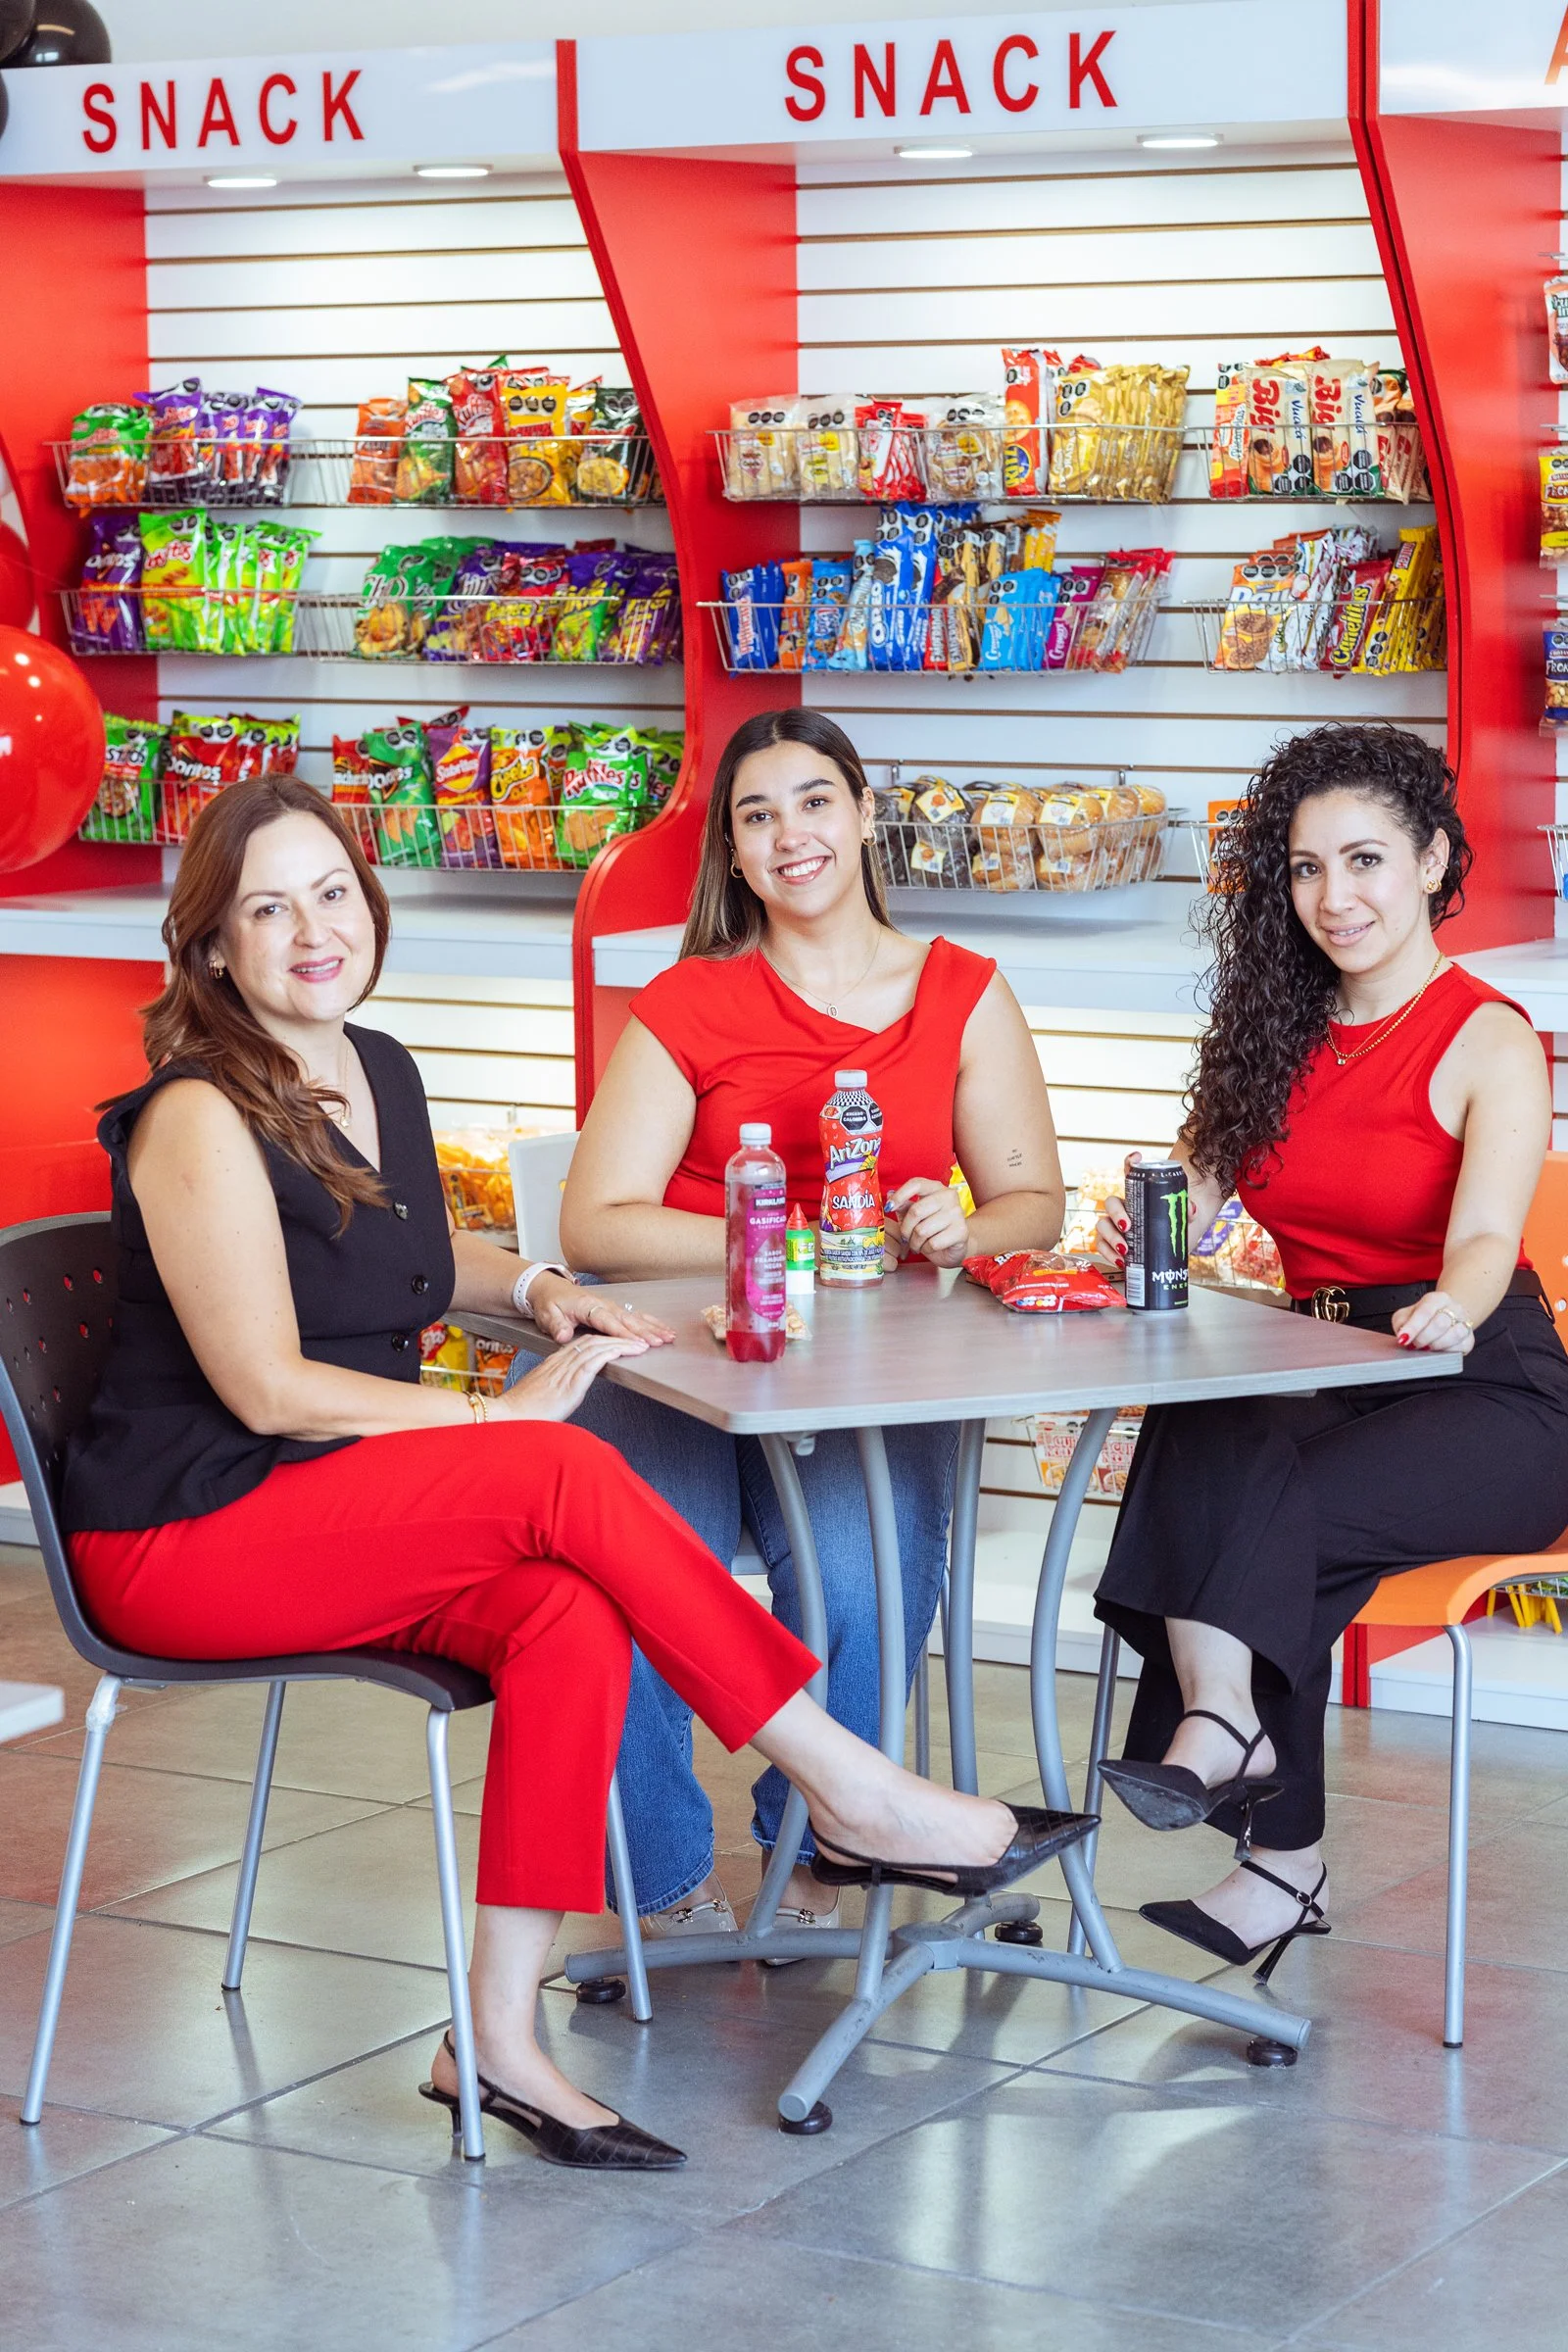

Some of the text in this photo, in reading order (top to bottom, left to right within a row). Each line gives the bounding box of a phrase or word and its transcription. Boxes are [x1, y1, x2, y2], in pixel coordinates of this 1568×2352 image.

[784, 30, 1118, 122] SNACK
[82, 69, 365, 154] SNACK
[1250, 378, 1281, 434] Big
[1311, 375, 1343, 432] Big
[871, 582, 887, 645] OREO
[832, 1189, 875, 1210] SANDÍA
